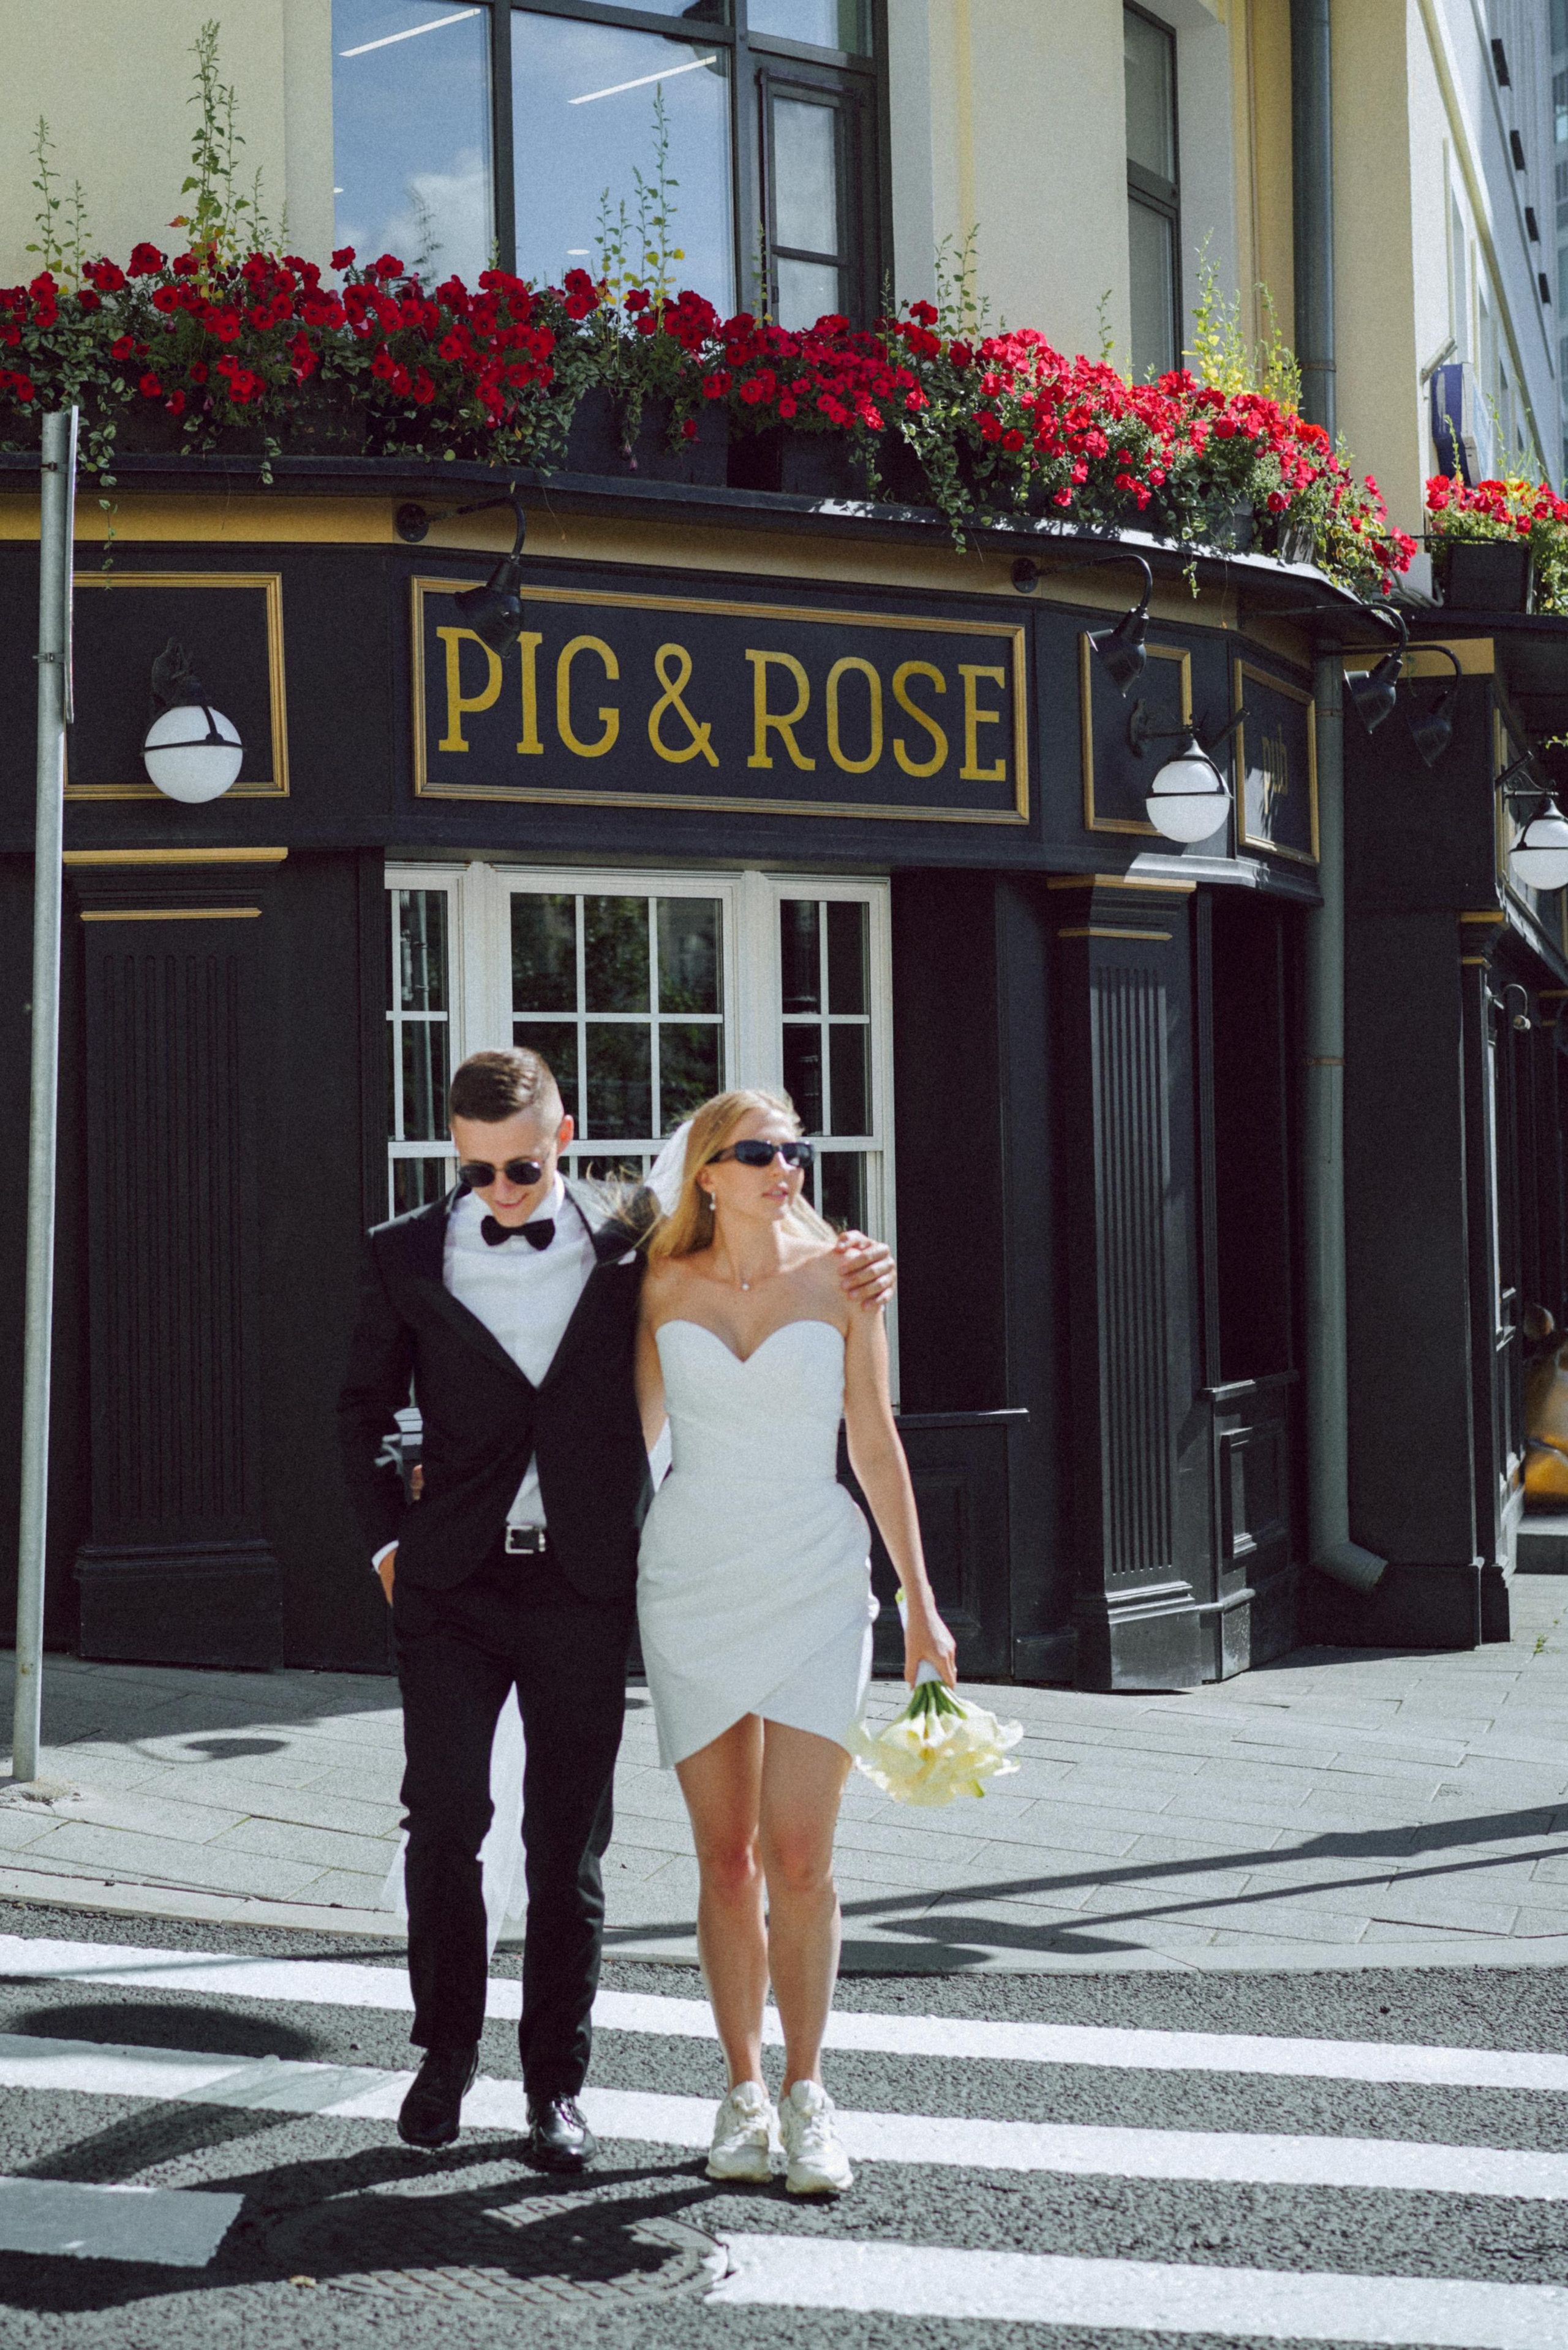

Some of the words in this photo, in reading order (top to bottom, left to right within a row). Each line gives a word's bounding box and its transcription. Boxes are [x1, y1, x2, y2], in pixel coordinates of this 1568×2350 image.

[436, 626, 619, 758] PIG
[647, 643, 720, 767] &
[745, 649, 1006, 781] ROSE
